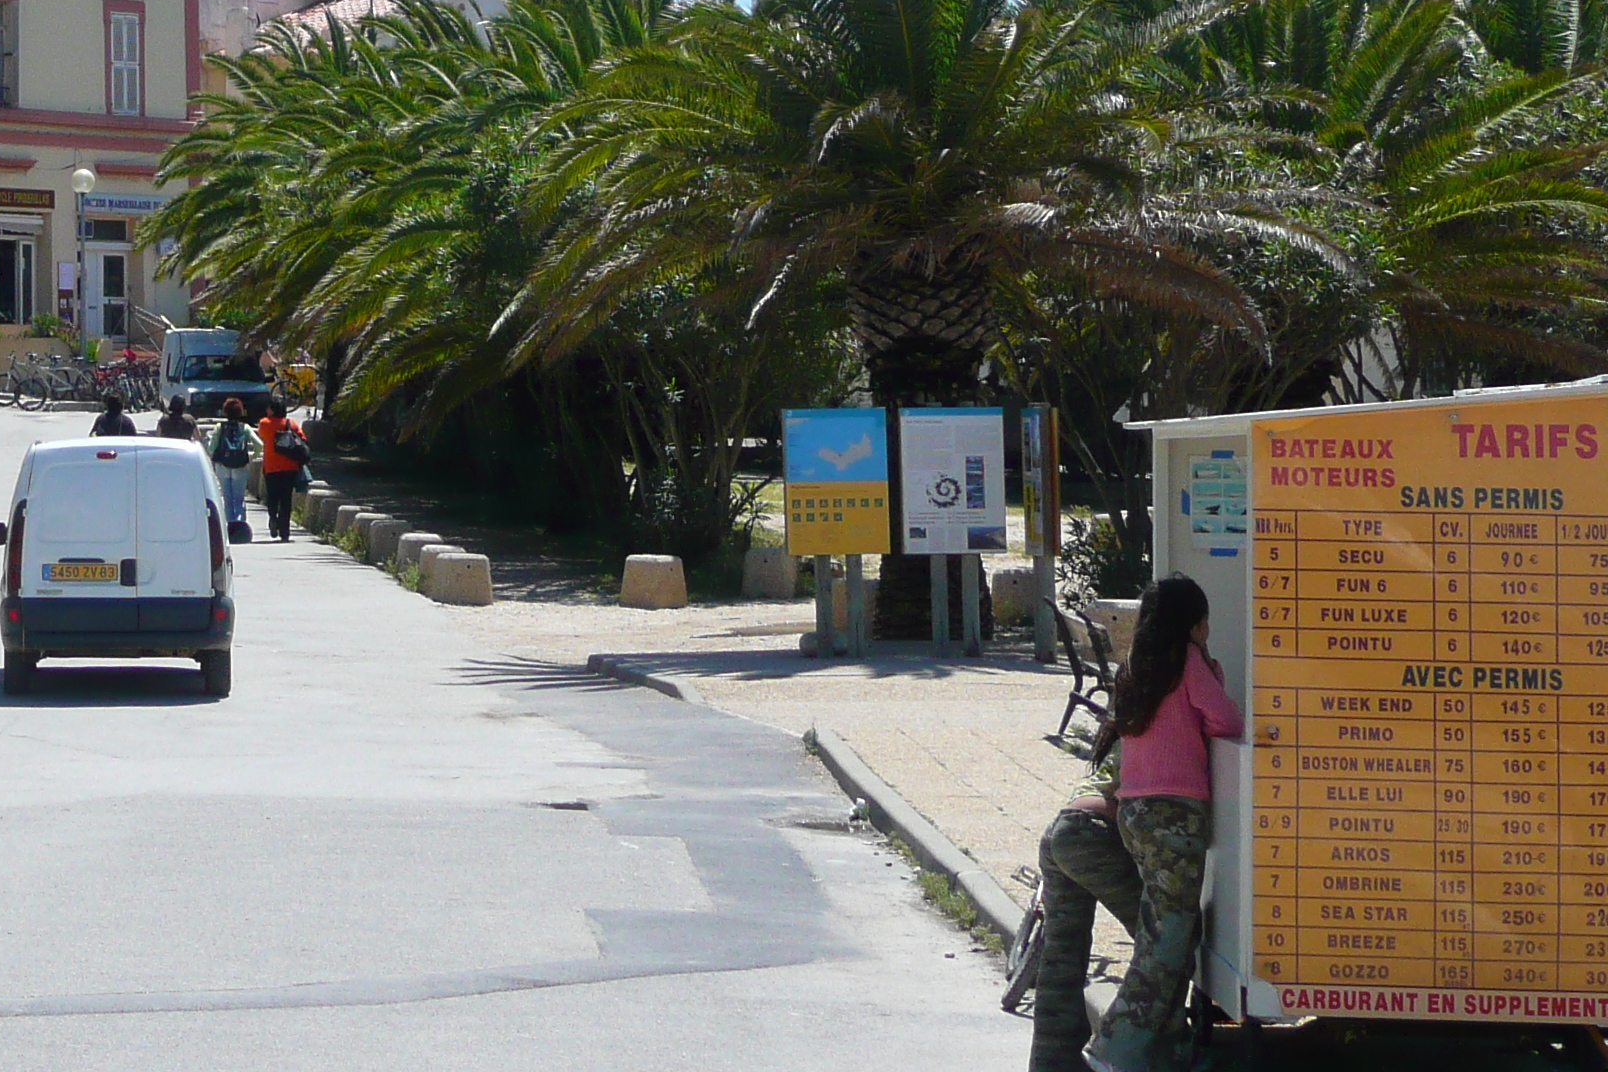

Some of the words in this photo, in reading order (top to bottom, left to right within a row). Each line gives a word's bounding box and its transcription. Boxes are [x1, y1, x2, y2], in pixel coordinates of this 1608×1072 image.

[1271, 438, 1393, 459] BATEAUX
[1451, 424, 1598, 459] TARIFS
[1272, 467, 1395, 488] MOTEURS
[1401, 486, 1464, 508] SANS
[1475, 488, 1563, 510] PERMIS
[1343, 520, 1382, 535] TYPE
[1440, 522, 1462, 537] CV.
[1486, 523, 1538, 539] JOURNEE
[1270, 548, 1278, 560] 5
[1339, 550, 1383, 564] SECU
[1447, 551, 1456, 564] 6
[1501, 552, 1523, 567] 90
[50, 567, 80, 579] 5450
[100, 567, 115, 579] 83
[1259, 576, 1290, 589] 6/7
[1337, 579, 1369, 592] FUN
[1377, 579, 1386, 592] 6
[1448, 579, 1457, 592] 6
[1501, 581, 1526, 594] 110
[1260, 607, 1290, 620] 6/7
[1321, 608, 1354, 622] FUN
[1362, 609, 1406, 623] LUXE
[1448, 608, 1457, 622] 6
[1272, 635, 1280, 648] 6
[1328, 637, 1391, 651] POINTU
[1448, 639, 1456, 652] 6
[1402, 666, 1462, 687] AVEC
[1473, 667, 1562, 690] PERMIS
[1272, 696, 1281, 709] 5
[1321, 697, 1370, 711] WEEK
[1379, 698, 1412, 712] END
[1444, 699, 1464, 713] 50
[1501, 700, 1529, 714] 145
[1339, 727, 1393, 741] PRIMO
[1444, 728, 1464, 741] 50
[1503, 728, 1531, 743] 155
[1272, 755, 1281, 768] 6
[1302, 757, 1358, 771] BOSTON
[1364, 758, 1431, 773] WHEALER
[1445, 759, 1464, 772] 75
[1503, 759, 1532, 773] 160
[1272, 786, 1280, 799] 7
[1327, 787, 1369, 801] ELLE
[1376, 788, 1402, 802] LUI
[1444, 789, 1465, 803] 90
[1503, 790, 1530, 804] 190
[1329, 818, 1394, 833] POINTU
[1502, 820, 1531, 834] 190
[1271, 845, 1279, 858] 7
[1331, 847, 1390, 862] ARKOS
[1440, 850, 1465, 863] 115
[1271, 875, 1279, 888] 7
[1323, 876, 1401, 892] OMBRINE
[1440, 880, 1466, 894] 115
[1272, 906, 1281, 918] 8
[1321, 907, 1355, 920] SEA
[1364, 908, 1407, 921] STAR
[1441, 910, 1466, 923] 115
[1267, 934, 1284, 947] 10
[1328, 935, 1395, 950] BREEZE
[1441, 937, 1466, 951] 115
[1272, 961, 1281, 975] 8
[1330, 964, 1389, 978] GOZZO
[1440, 966, 1468, 979] 165
[1282, 989, 1418, 1013] CARBURANT
[1428, 993, 1454, 1013] EN
[1464, 995, 1608, 1017] SUPPLEMENT
